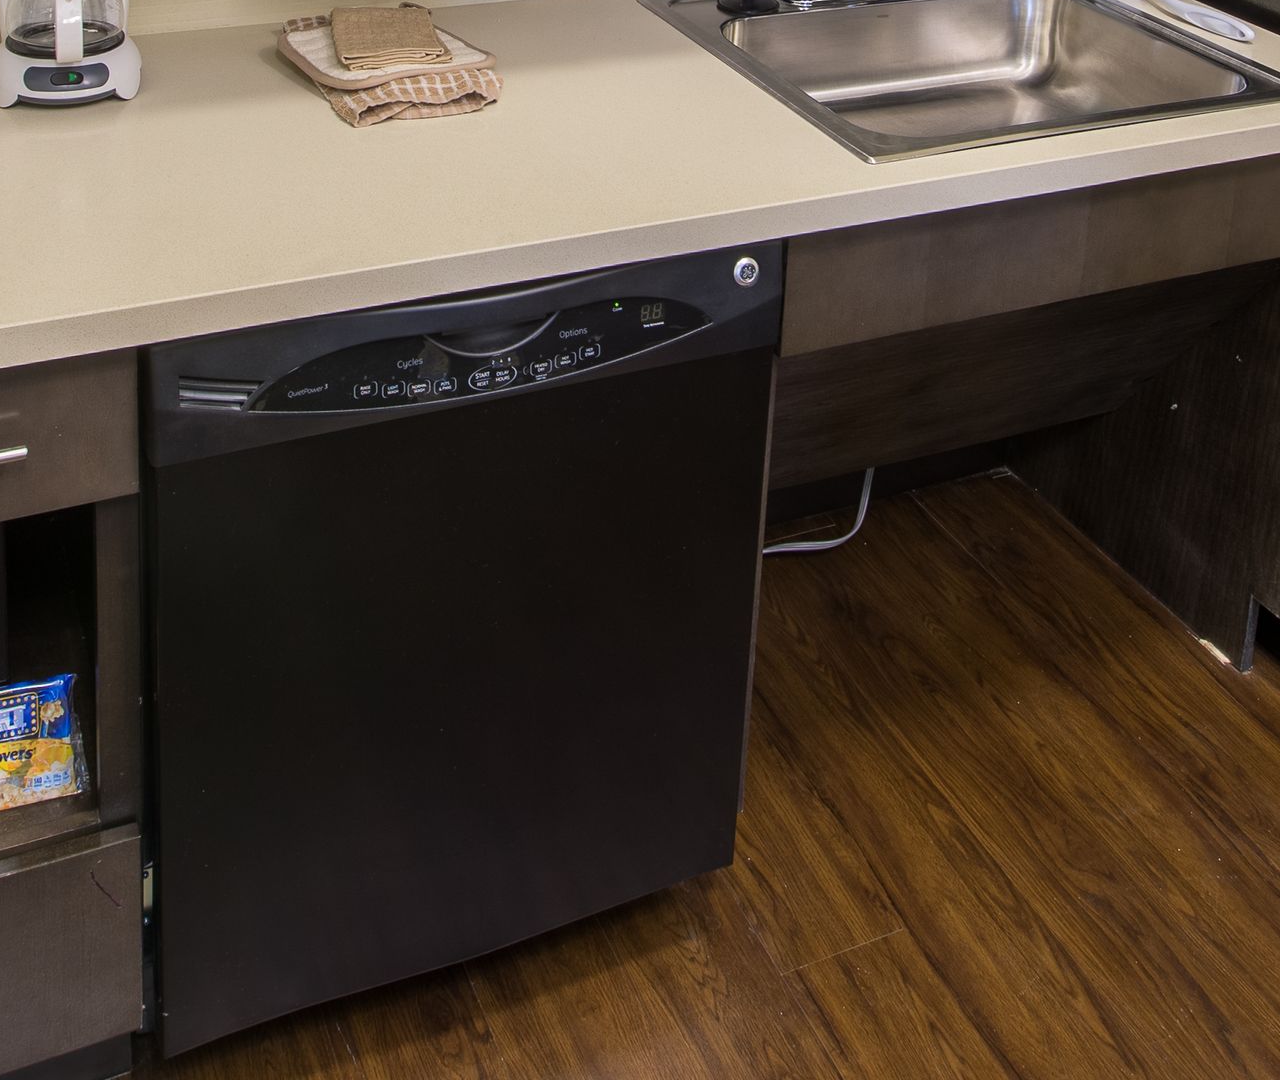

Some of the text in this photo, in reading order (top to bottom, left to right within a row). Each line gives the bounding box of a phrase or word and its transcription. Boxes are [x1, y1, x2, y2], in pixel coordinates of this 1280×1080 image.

[559, 327, 588, 339] Options
[396, 357, 424, 370] Cycles
[475, 372, 490, 380] START
